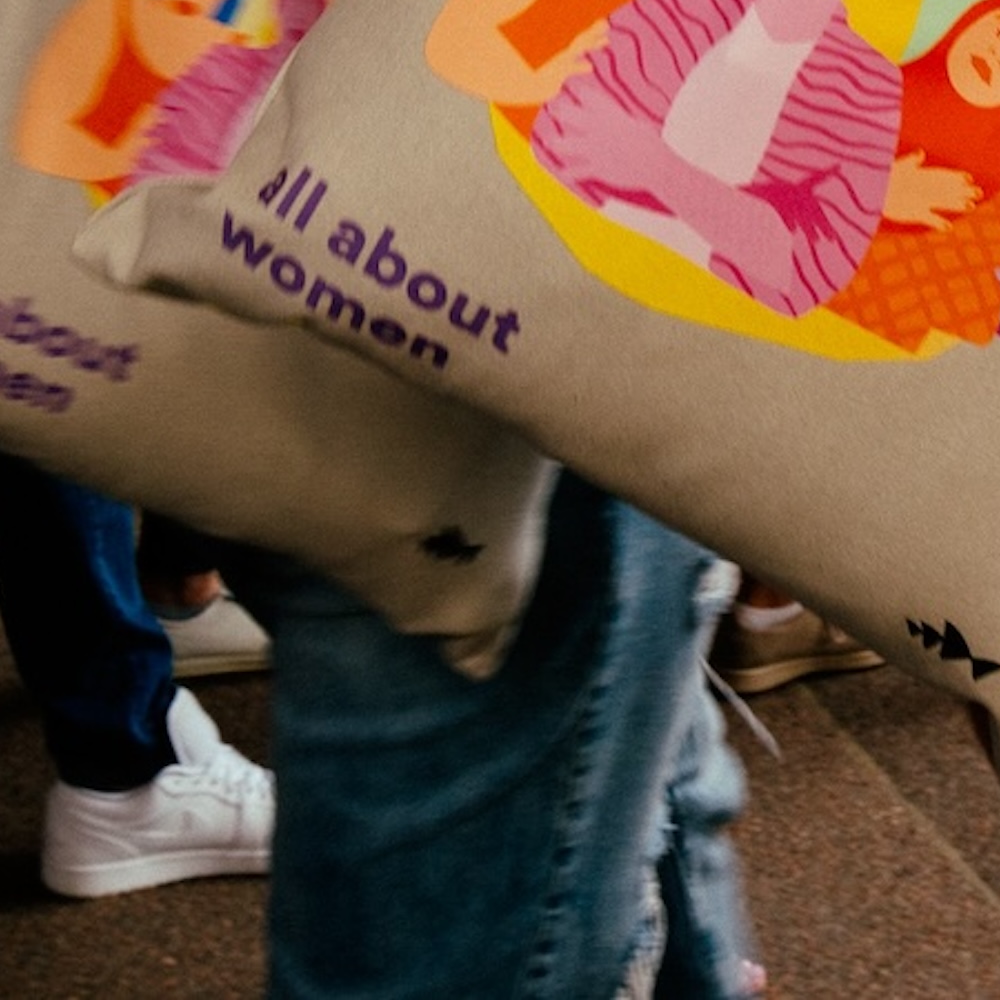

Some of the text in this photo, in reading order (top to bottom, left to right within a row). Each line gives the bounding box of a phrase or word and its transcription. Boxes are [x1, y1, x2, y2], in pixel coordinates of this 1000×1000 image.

[0, 297, 140, 383] bout
[221, 208, 449, 369] women
[258, 166, 521, 354] all about
